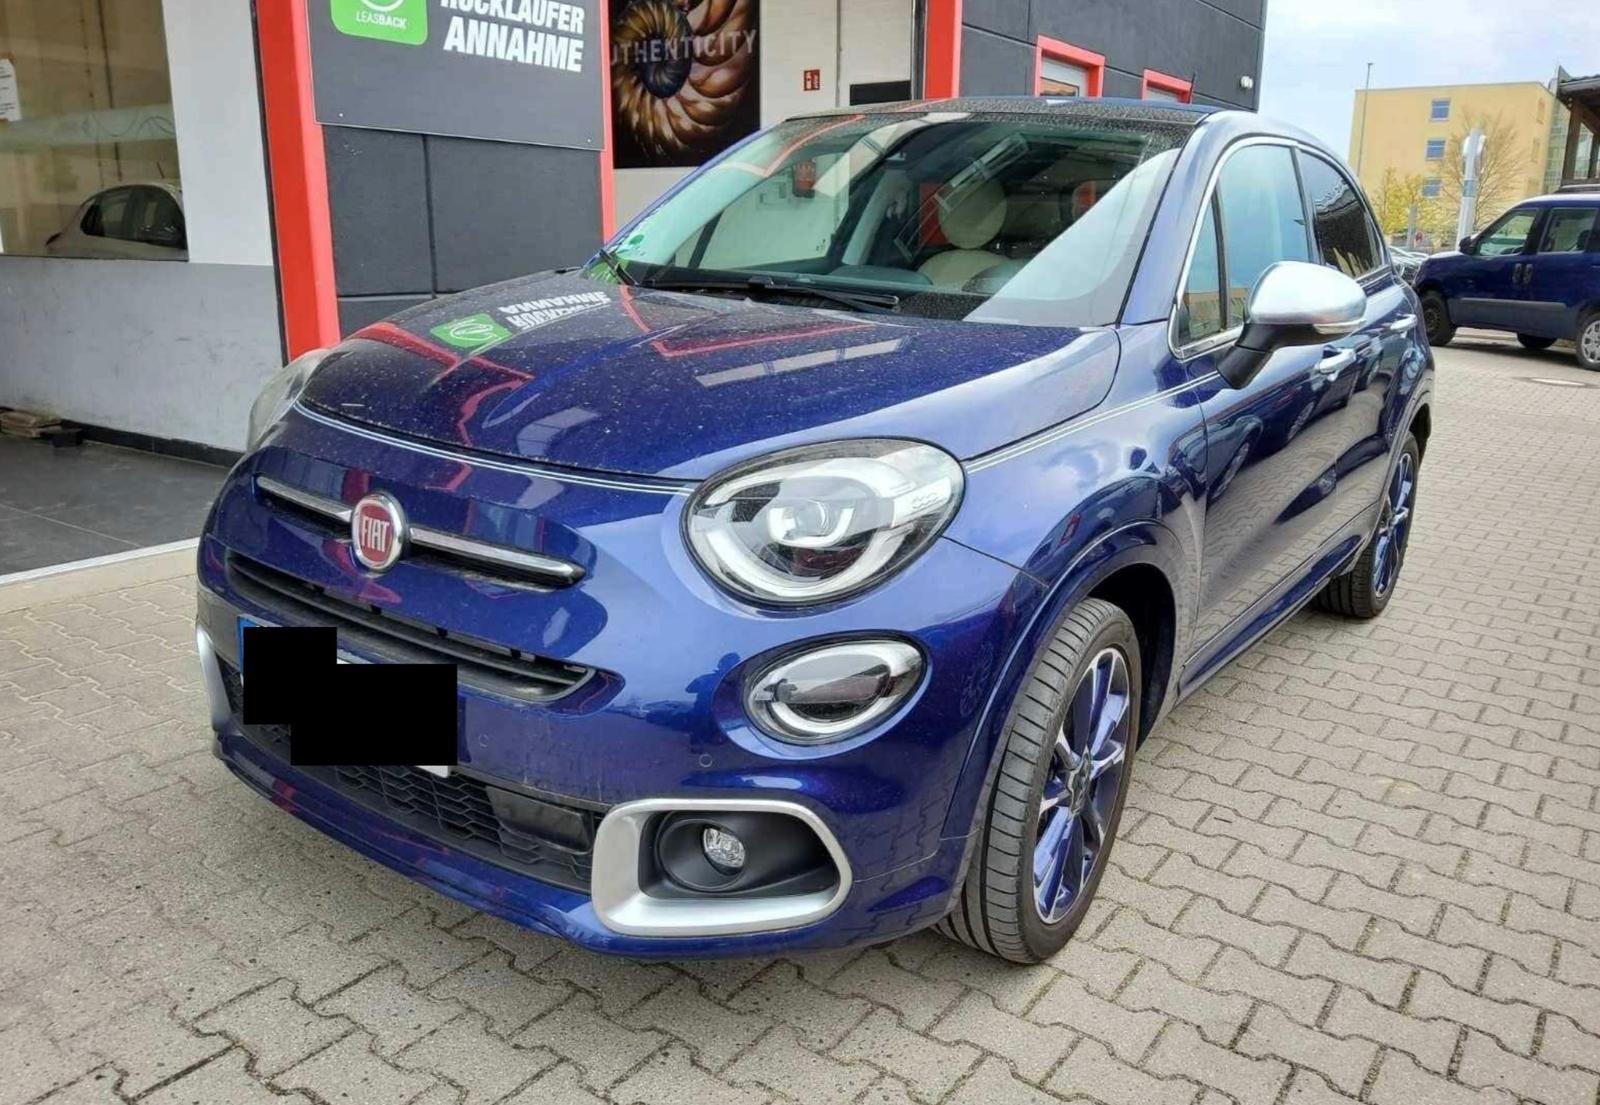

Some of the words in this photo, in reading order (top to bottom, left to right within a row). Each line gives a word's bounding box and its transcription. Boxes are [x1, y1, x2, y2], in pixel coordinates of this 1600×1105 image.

[355, 10, 408, 29] LEASBACK
[443, 15, 585, 72] ANNAHME
[360, 514, 390, 552] FIAT
